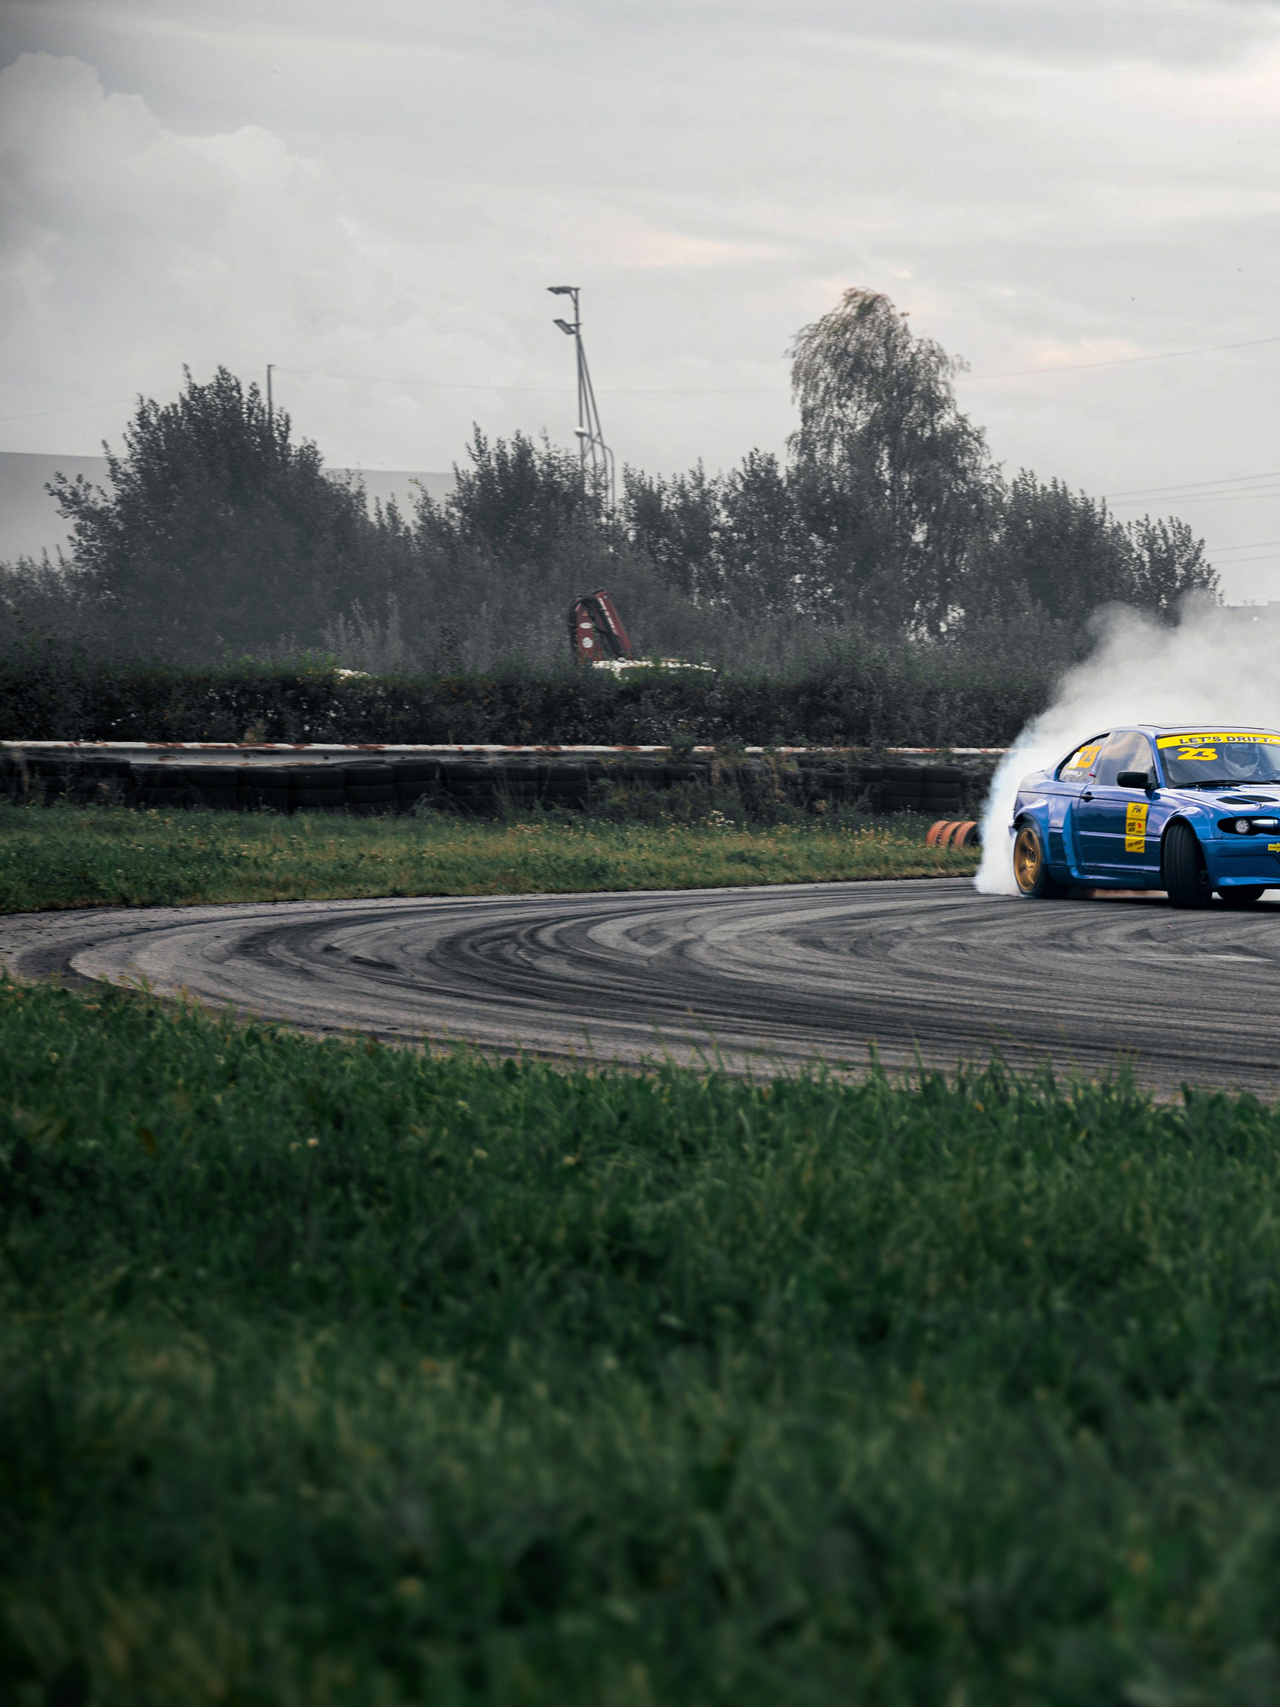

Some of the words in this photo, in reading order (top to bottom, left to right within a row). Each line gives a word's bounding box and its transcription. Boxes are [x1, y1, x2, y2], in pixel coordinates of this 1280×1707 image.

[1180, 736, 1222, 744] LET'S
[1226, 736, 1269, 744] DRIFT
[1177, 747, 1218, 760] 23
